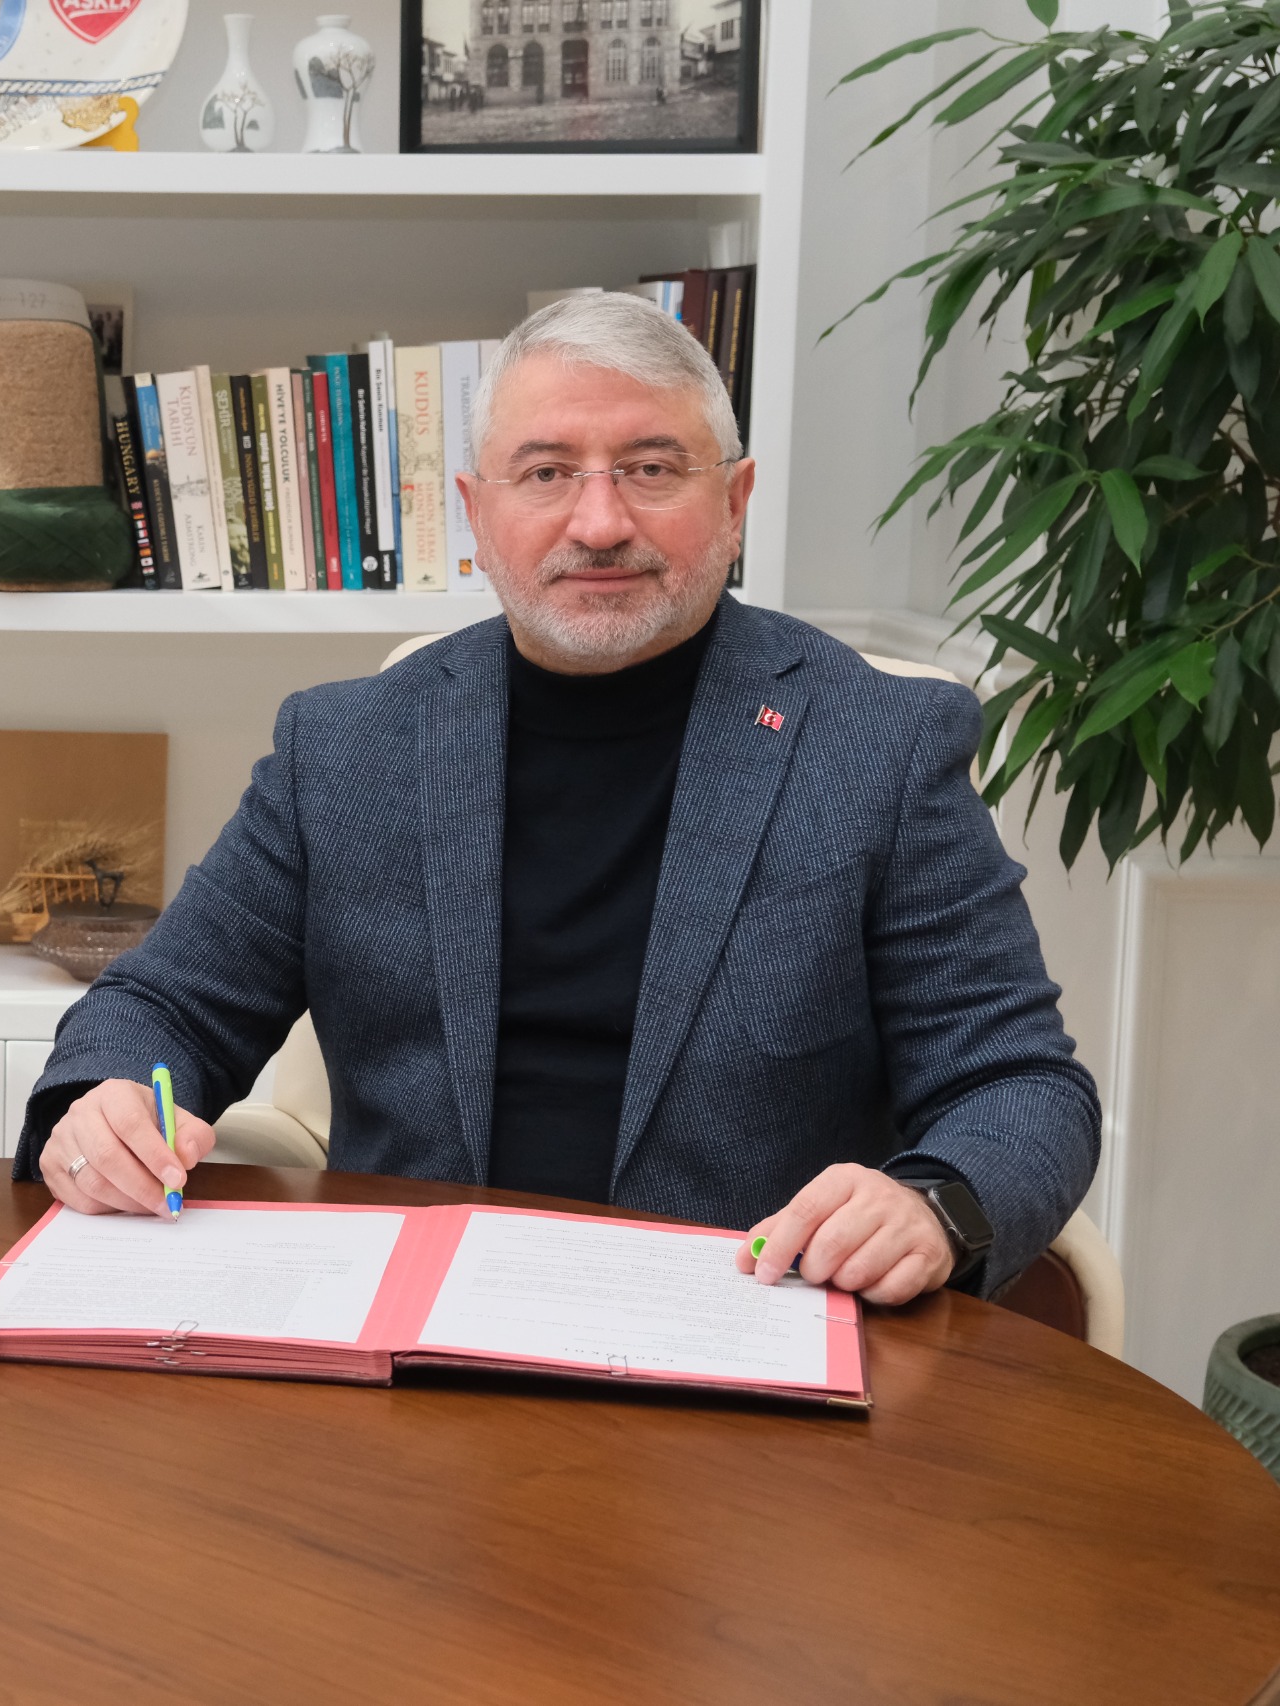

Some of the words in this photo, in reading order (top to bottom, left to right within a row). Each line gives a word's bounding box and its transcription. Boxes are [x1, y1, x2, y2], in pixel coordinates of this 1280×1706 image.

[166, 398, 183, 448] TARİHİ
[178, 385, 199, 457] KUDÜS'ÜN
[216, 389, 233, 429] ŞEHİR
[275, 384, 289, 425] HİVE'YE
[414, 370, 431, 436] KUDÜS
[116, 420, 140, 495] HUNGARY
[278, 429, 292, 483] YOLCULUK
[222, 478, 237, 520] WEBER
[231, 476, 244, 504] MAX
[425, 481, 436, 522] SIMON
[183, 513, 198, 567] ARMSTRONG
[414, 483, 426, 563] MONTEFIORE
[426, 526, 437, 564] SEBAG
